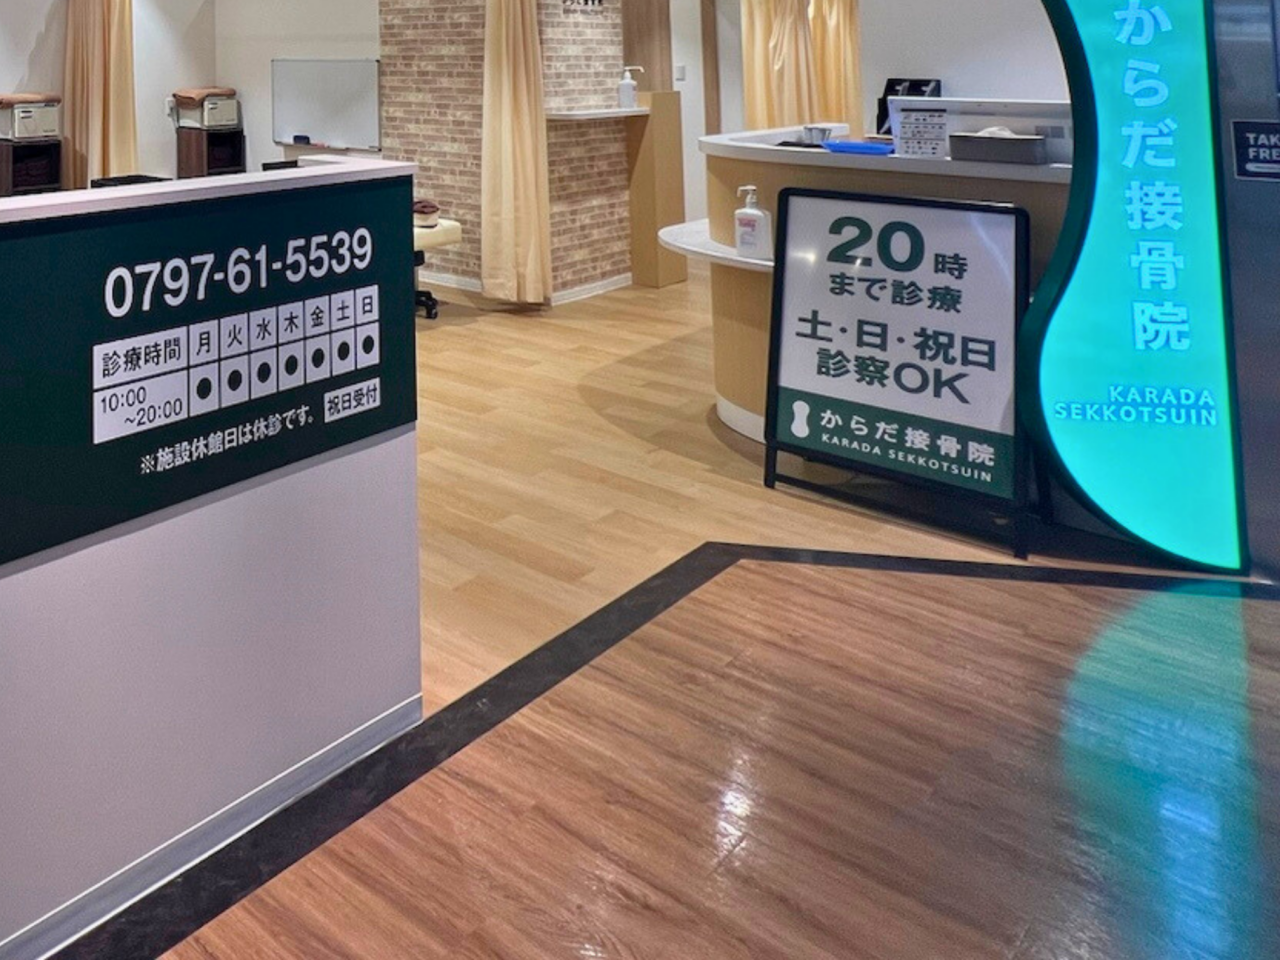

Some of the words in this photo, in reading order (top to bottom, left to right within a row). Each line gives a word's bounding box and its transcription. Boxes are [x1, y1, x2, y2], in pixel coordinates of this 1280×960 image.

[104, 227, 373, 318] 0797-61-5539
[826, 216, 969, 281] 20時
[828, 272, 963, 314] まで診療
[102, 336, 182, 379] 診療時間
[196, 329, 211, 356] 月
[227, 324, 243, 348] 火
[256, 317, 271, 340] 水
[284, 311, 299, 334] 木
[310, 305, 325, 328] 金
[336, 300, 350, 322] 土
[362, 295, 373, 315] 日
[795, 309, 997, 371] 土・日・祝日
[100, 386, 147, 414] 10:00
[326, 386, 378, 418] 祝日受付
[816, 347, 970, 405] 診察OK
[1110, 386, 1215, 406] KARADA
[820, 409, 996, 466] からだ接骨院
[1055, 402, 1217, 426] SEKKOTSUIN
[821, 433, 882, 456] KARADA
[888, 449, 993, 482] SEKKOTSUIN
